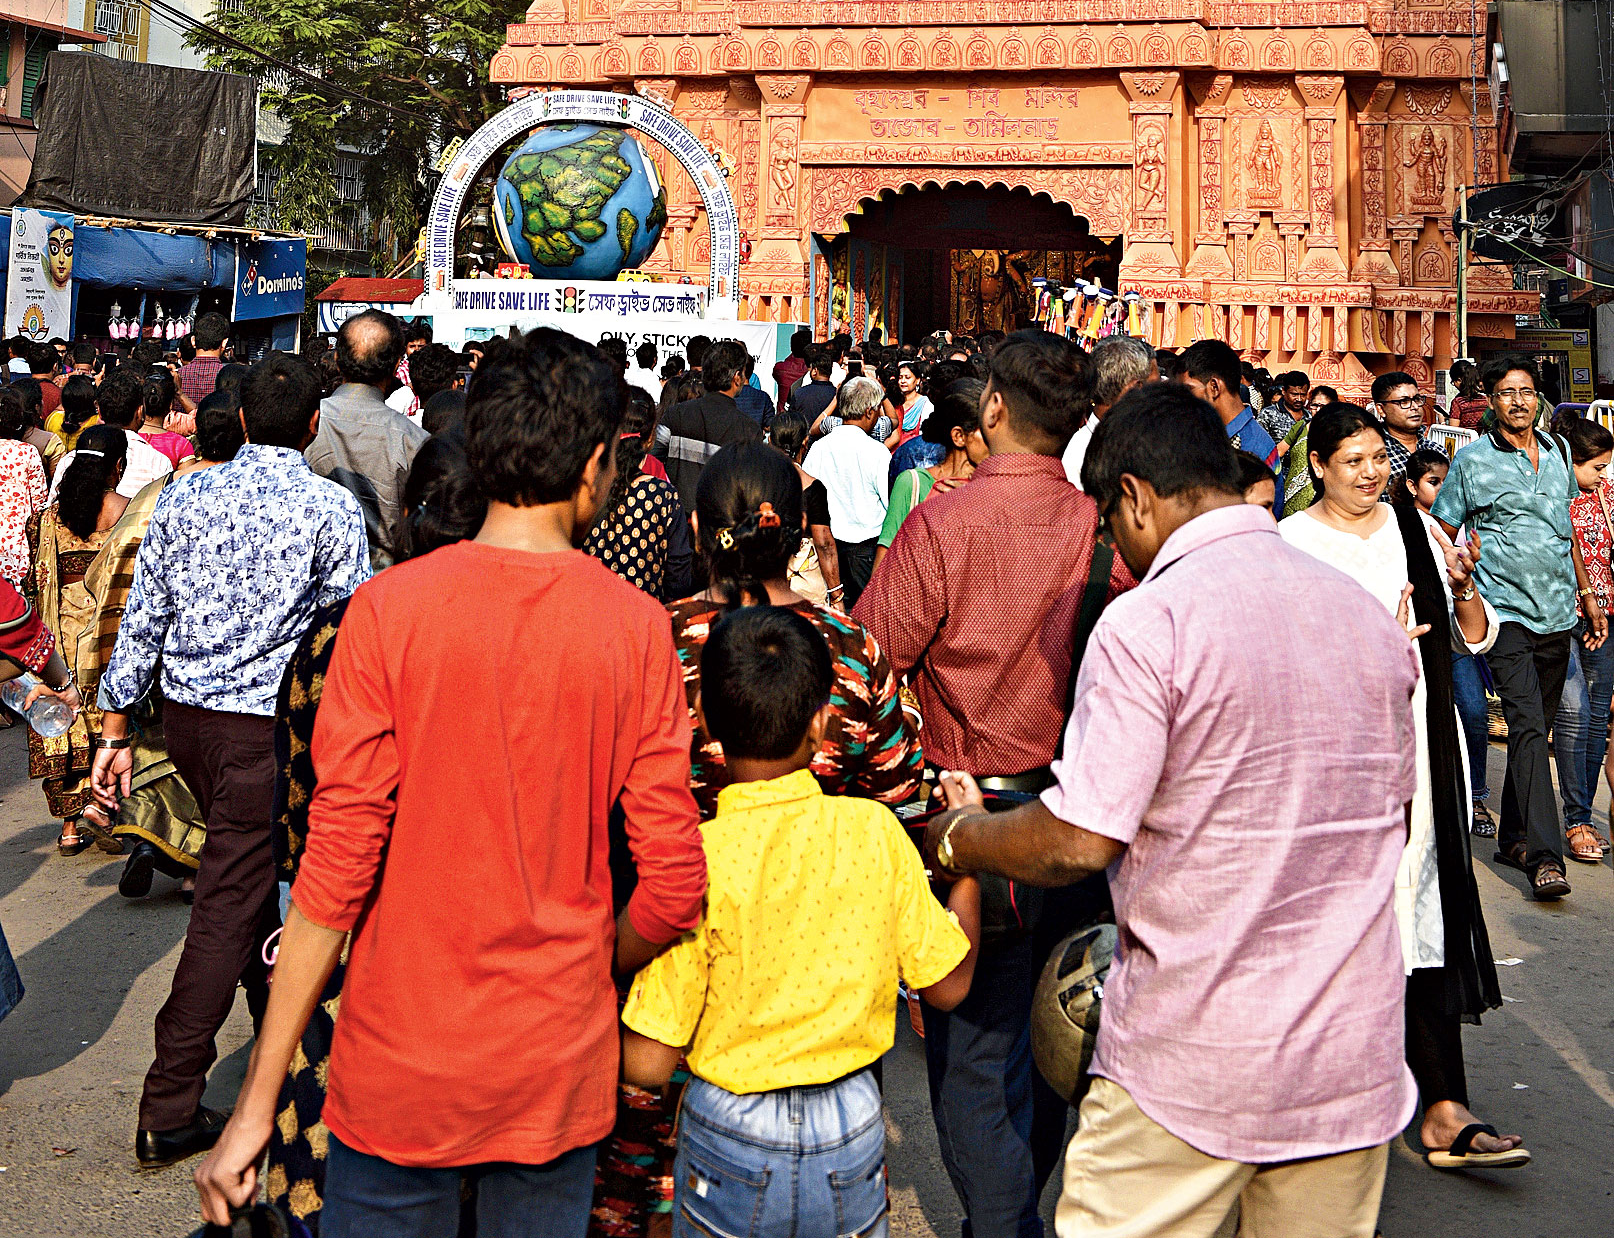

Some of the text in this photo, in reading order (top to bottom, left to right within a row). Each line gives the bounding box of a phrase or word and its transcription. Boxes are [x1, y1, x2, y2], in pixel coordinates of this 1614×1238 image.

[553, 94, 616, 105] SAFE DRIVE SAVE LIFE
[639, 108, 708, 169] SAFE DRIVE SAVE LIFE
[433, 185, 458, 268] SAFE DRIVE SAVE LIFE
[257, 271, 303, 295] Domino's
[455, 291, 550, 311] SAFE DRIVE SAVE LIFE
[588, 293, 616, 311] সেফ
[617, 289, 651, 316] ড্রাইভ
[652, 295, 675, 313] সেভ
[642, 333, 690, 348] STICK
